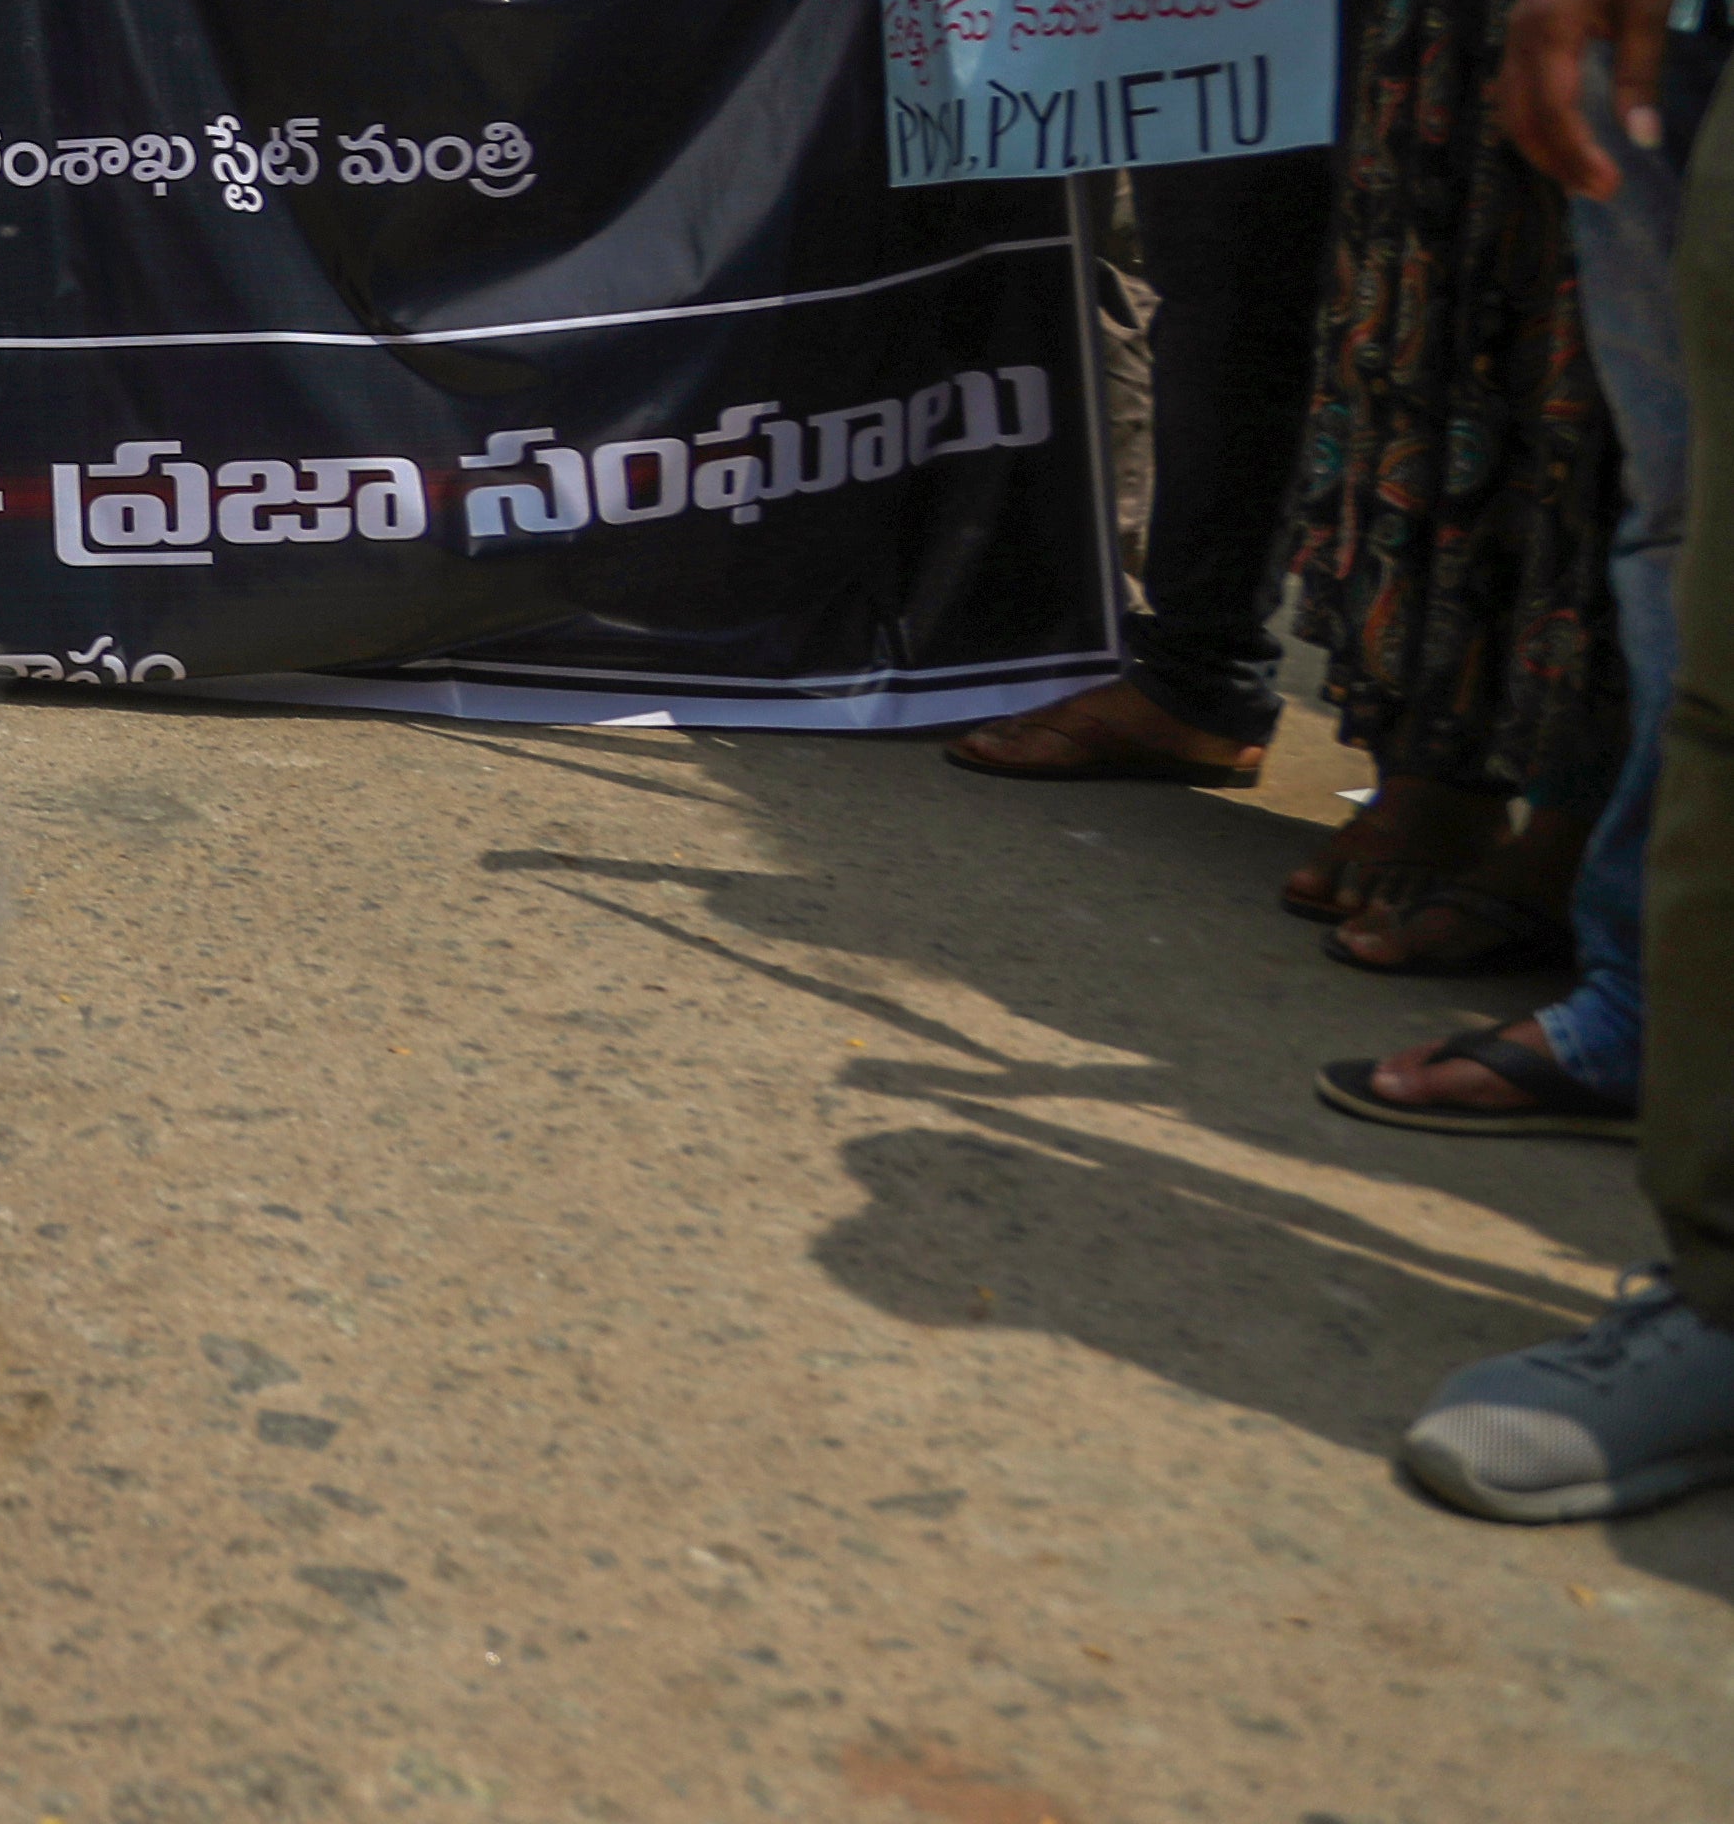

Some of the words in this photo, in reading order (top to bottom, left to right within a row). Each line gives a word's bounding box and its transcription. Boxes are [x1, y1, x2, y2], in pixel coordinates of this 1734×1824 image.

[205, 115, 321, 213] స్టేట్
[337, 120, 537, 198] మంత్రి
[51, 438, 428, 567] ప్రజా
[459, 364, 1053, 539] సంఘాలు
